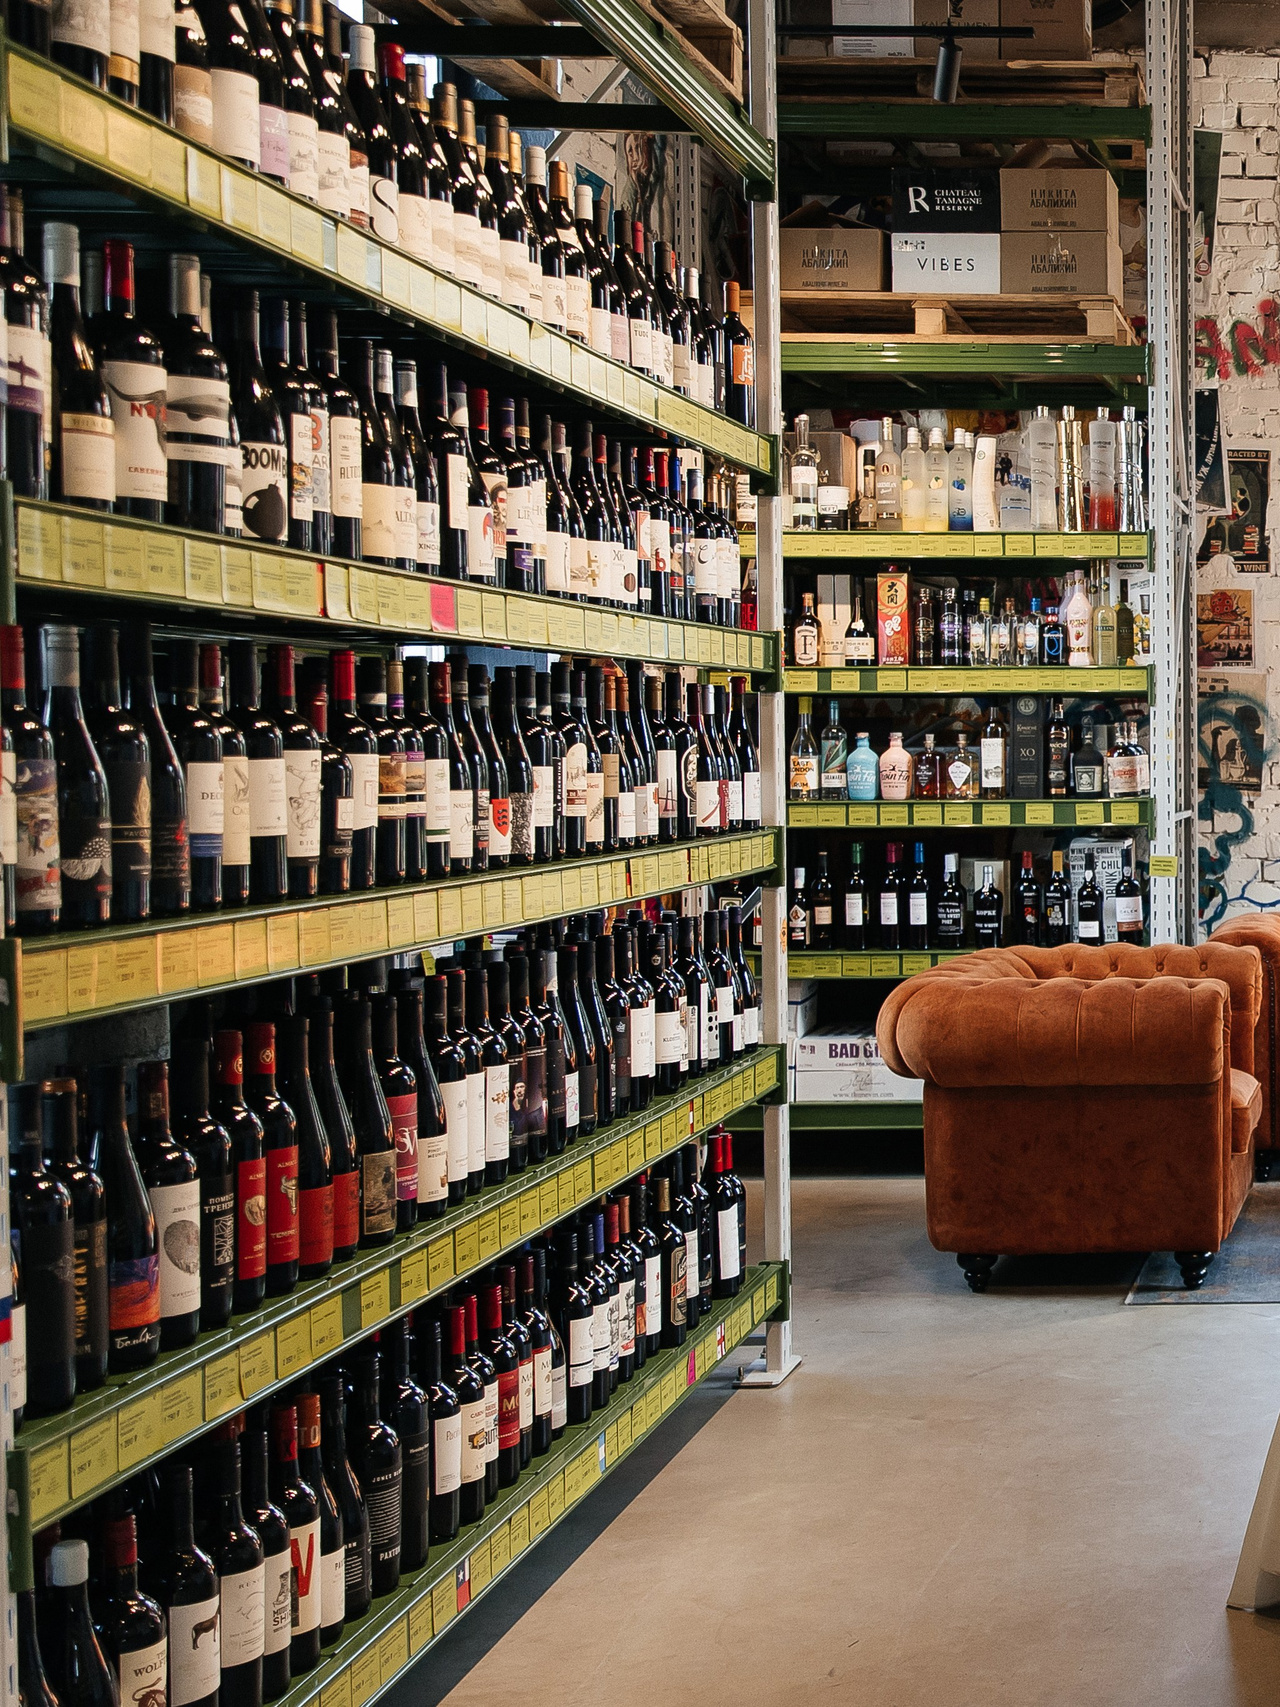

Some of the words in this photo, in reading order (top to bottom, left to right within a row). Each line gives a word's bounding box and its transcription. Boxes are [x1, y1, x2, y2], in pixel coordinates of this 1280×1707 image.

[934, 189, 981, 197] CHATEAU
[1030, 188, 1077, 198] НИКИТА
[908, 186, 930, 214] R
[935, 197, 982, 205] TAMAGNE
[1030, 199, 1077, 208] АБАЛИХИН
[917, 257, 975, 271] VIBES
[1019, 748, 1036, 757] XO
[1101, 860, 1121, 870] CHIL
[828, 1043, 860, 1058] BAD
[863, 1043, 881, 1059] GI
[208, 1192, 234, 1205] ПОМЕСТ
[372, 1474, 392, 1483] JONES
[379, 1547, 400, 1562] PAXTO
